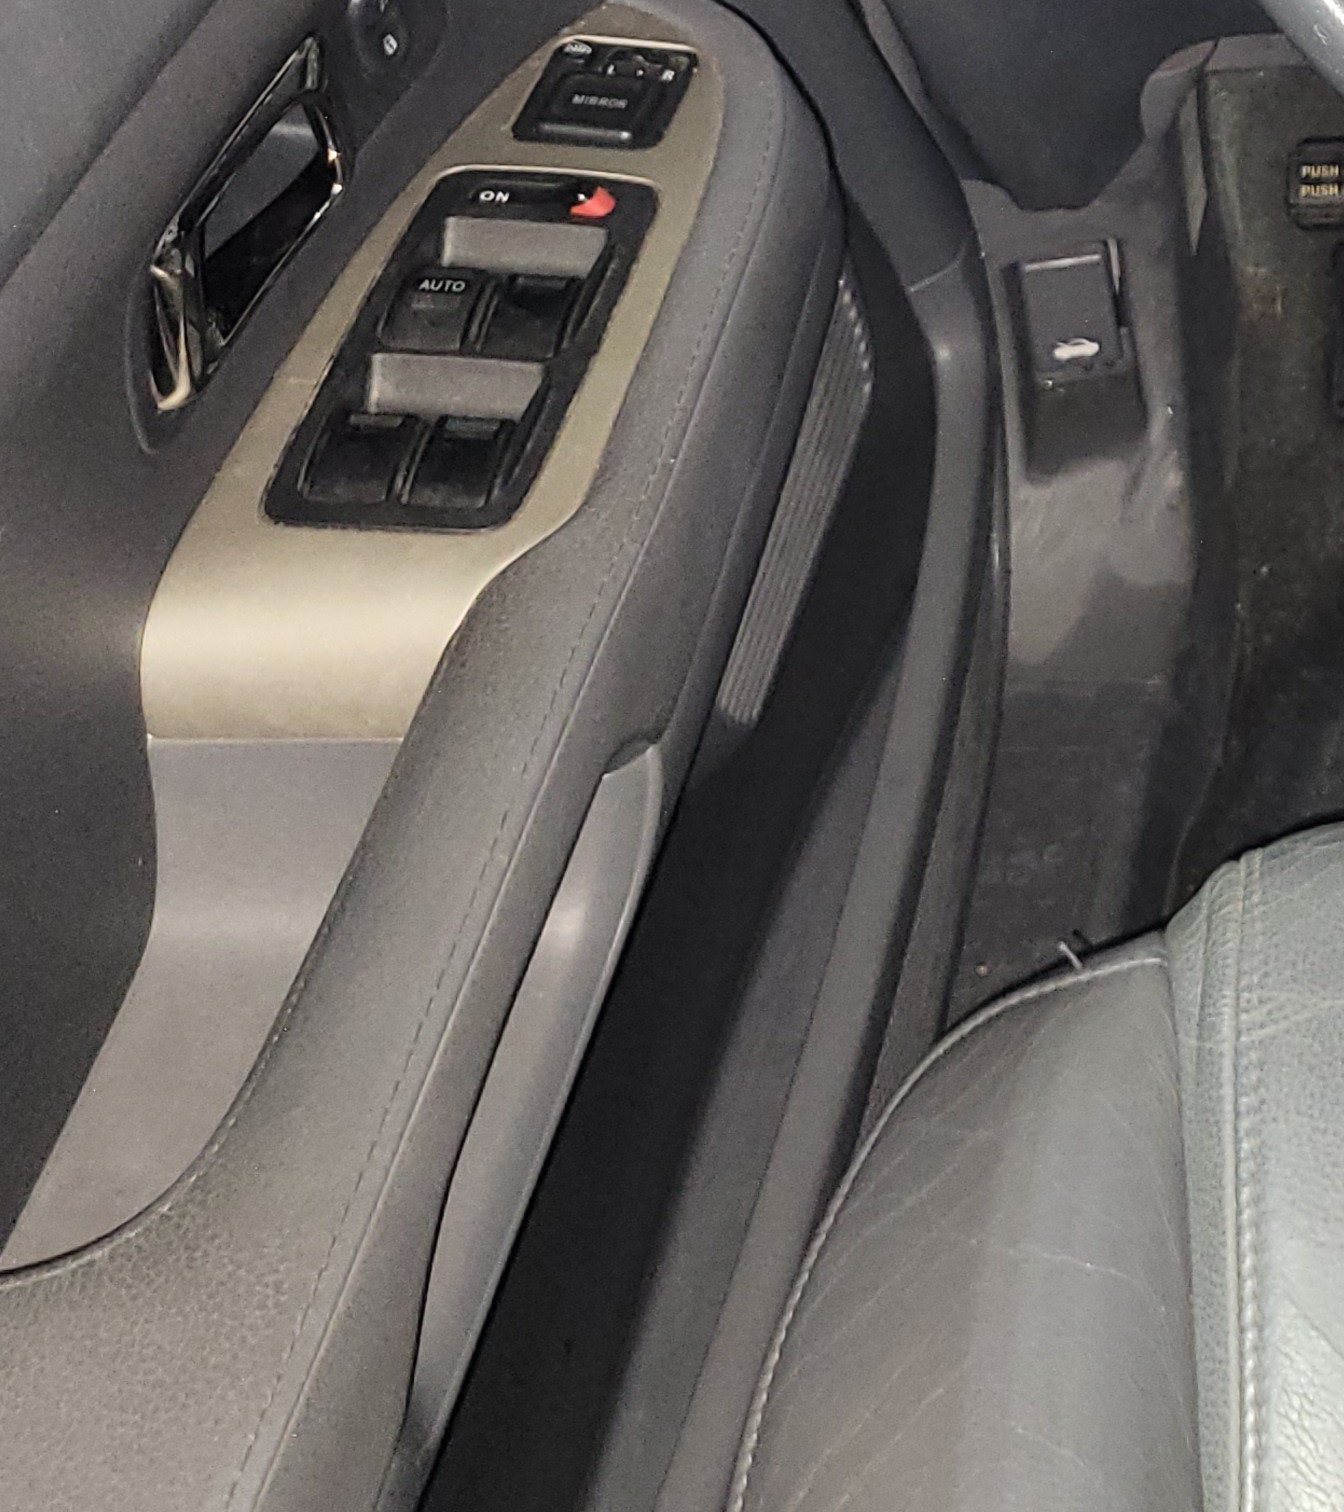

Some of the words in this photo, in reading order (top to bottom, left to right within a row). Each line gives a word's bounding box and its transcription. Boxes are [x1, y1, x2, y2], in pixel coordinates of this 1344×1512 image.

[661, 69, 675, 82] R
[572, 94, 628, 109] MIRROR
[1302, 165, 1339, 178] PUSH
[479, 191, 510, 203] ON
[1301, 184, 1340, 197] PUSH
[419, 279, 466, 292] AUTO
